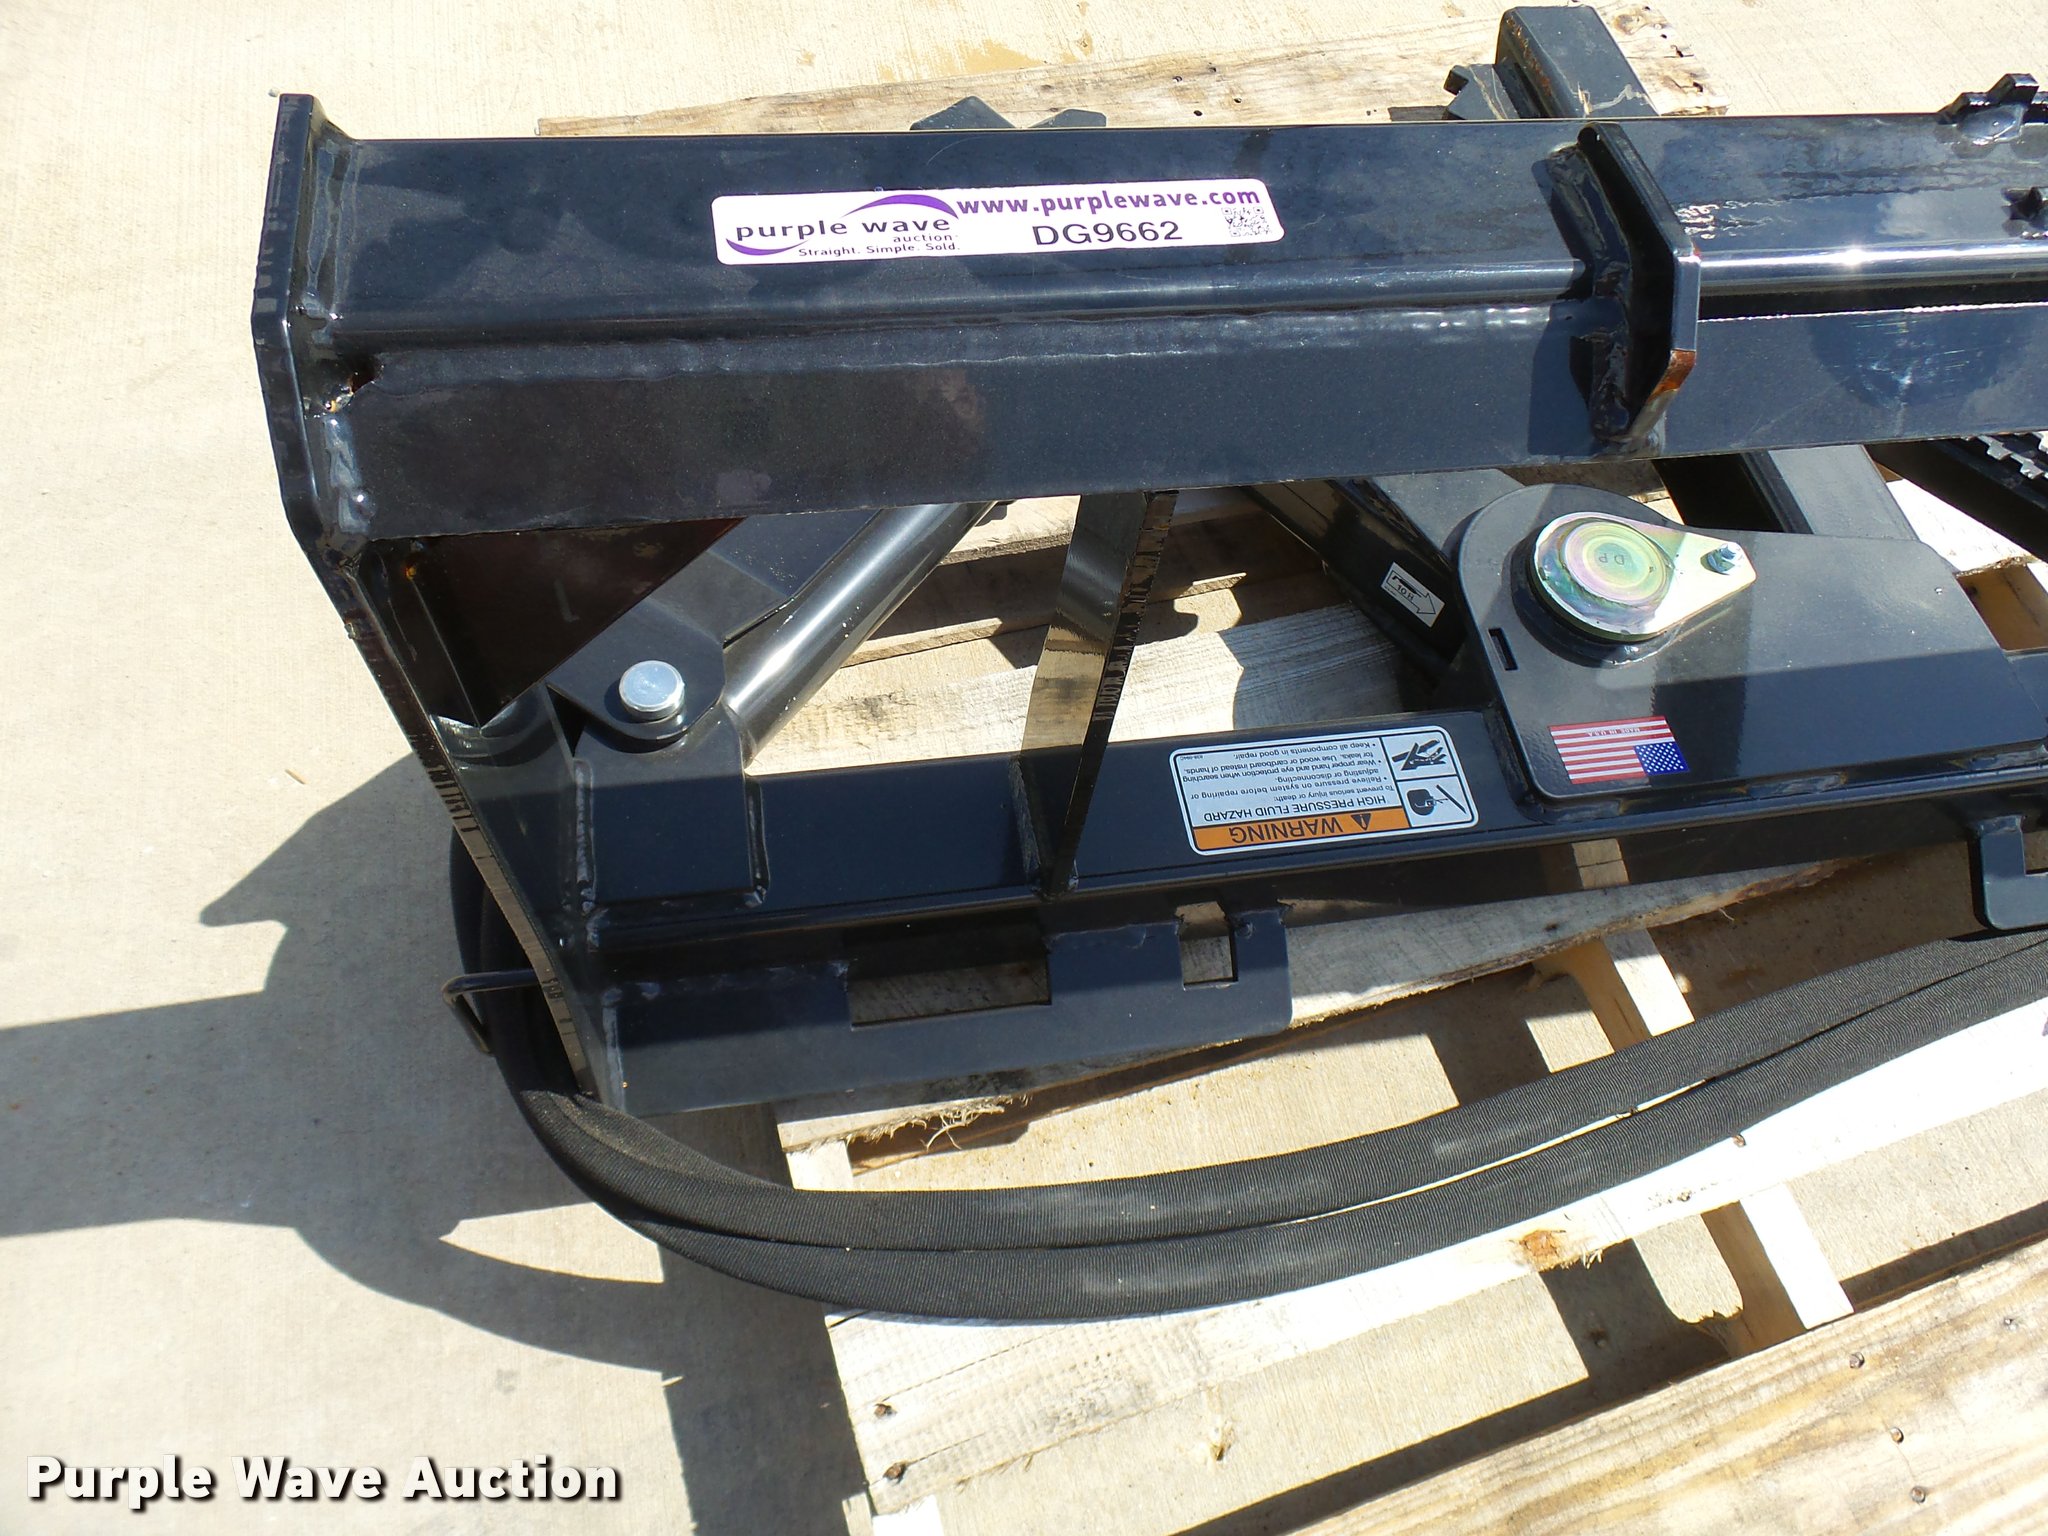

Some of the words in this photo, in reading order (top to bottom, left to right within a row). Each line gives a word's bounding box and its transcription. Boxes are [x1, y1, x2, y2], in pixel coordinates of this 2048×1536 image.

[956, 187, 1261, 216] www.purplewave.com
[736, 219, 848, 242] purple
[861, 218, 951, 234] wave
[1032, 220, 1183, 246] DG9662
[893, 233, 952, 243] auction
[798, 246, 861, 258] Straight.
[866, 243, 920, 255] Simple.
[925, 241, 961, 252] Sold.
[1291, 745, 1338, 755] components
[1234, 751, 1257, 760] repair.
[1259, 750, 1279, 760] good
[1249, 760, 1288, 770] cardboard
[1300, 757, 1320, 765] wood
[1332, 761, 1355, 769] proper
[1183, 767, 1210, 775] hands.
[1220, 764, 1247, 772] instead
[1296, 765, 1310, 773] and
[1344, 768, 1378, 777] adjusting
[1220, 772, 1240, 780] when
[1242, 768, 1279, 778] protection
[1182, 775, 1218, 783] searching
[1275, 773, 1332, 783] disconnecting.
[1352, 776, 1381, 785] Relieve
[1314, 779, 1349, 788] pressure
[1241, 787, 1267, 796] before
[1270, 784, 1298, 793] system
[1356, 785, 1383, 793] prevent
[1201, 790, 1238, 799] repairing
[1308, 790, 1327, 799] injury
[1357, 795, 1386, 806] HIGH
[1255, 805, 1289, 816] FLUID
[1292, 799, 1354, 813] PRESSURE
[1204, 809, 1251, 821] HAZARD
[1229, 817, 1343, 843] WARNING
